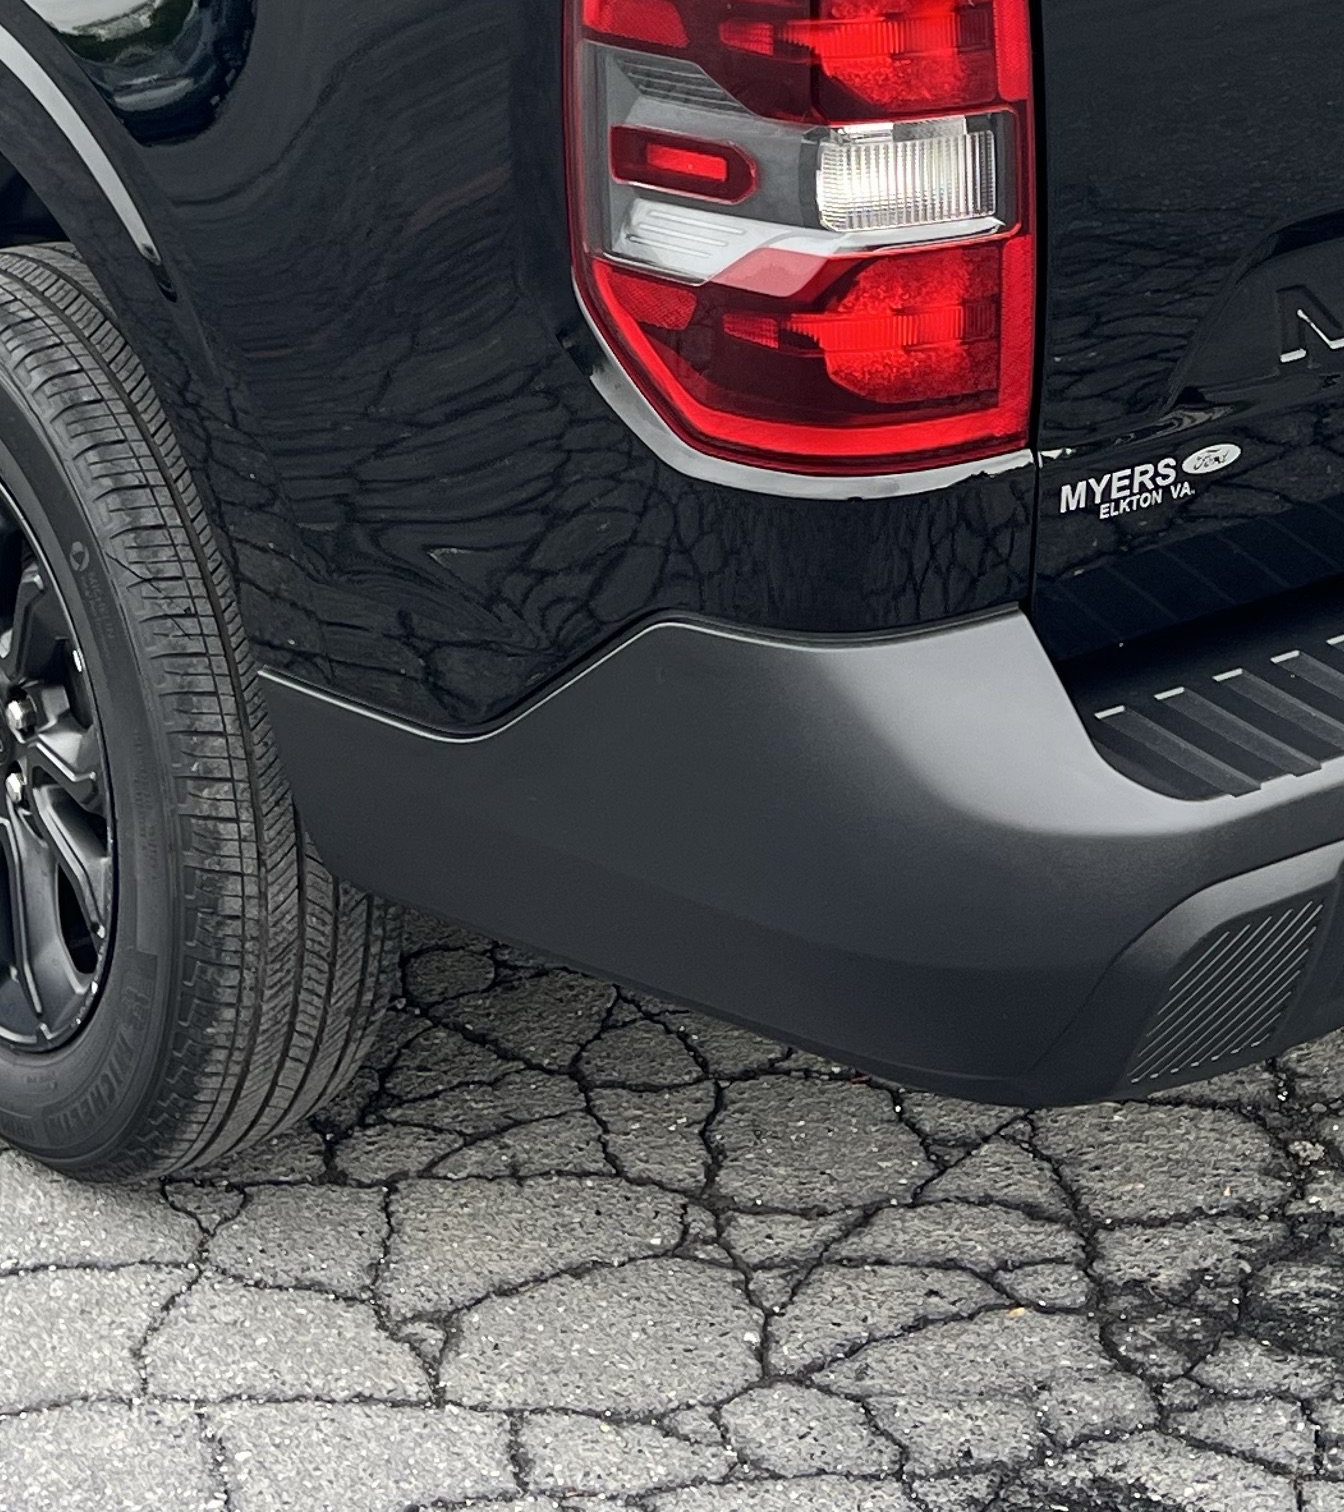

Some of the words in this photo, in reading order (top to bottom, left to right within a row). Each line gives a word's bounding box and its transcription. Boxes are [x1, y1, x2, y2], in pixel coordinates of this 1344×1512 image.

[1059, 457, 1177, 514] MYERS
[1099, 489, 1163, 519] ELKTON
[1170, 482, 1196, 500] VA.
